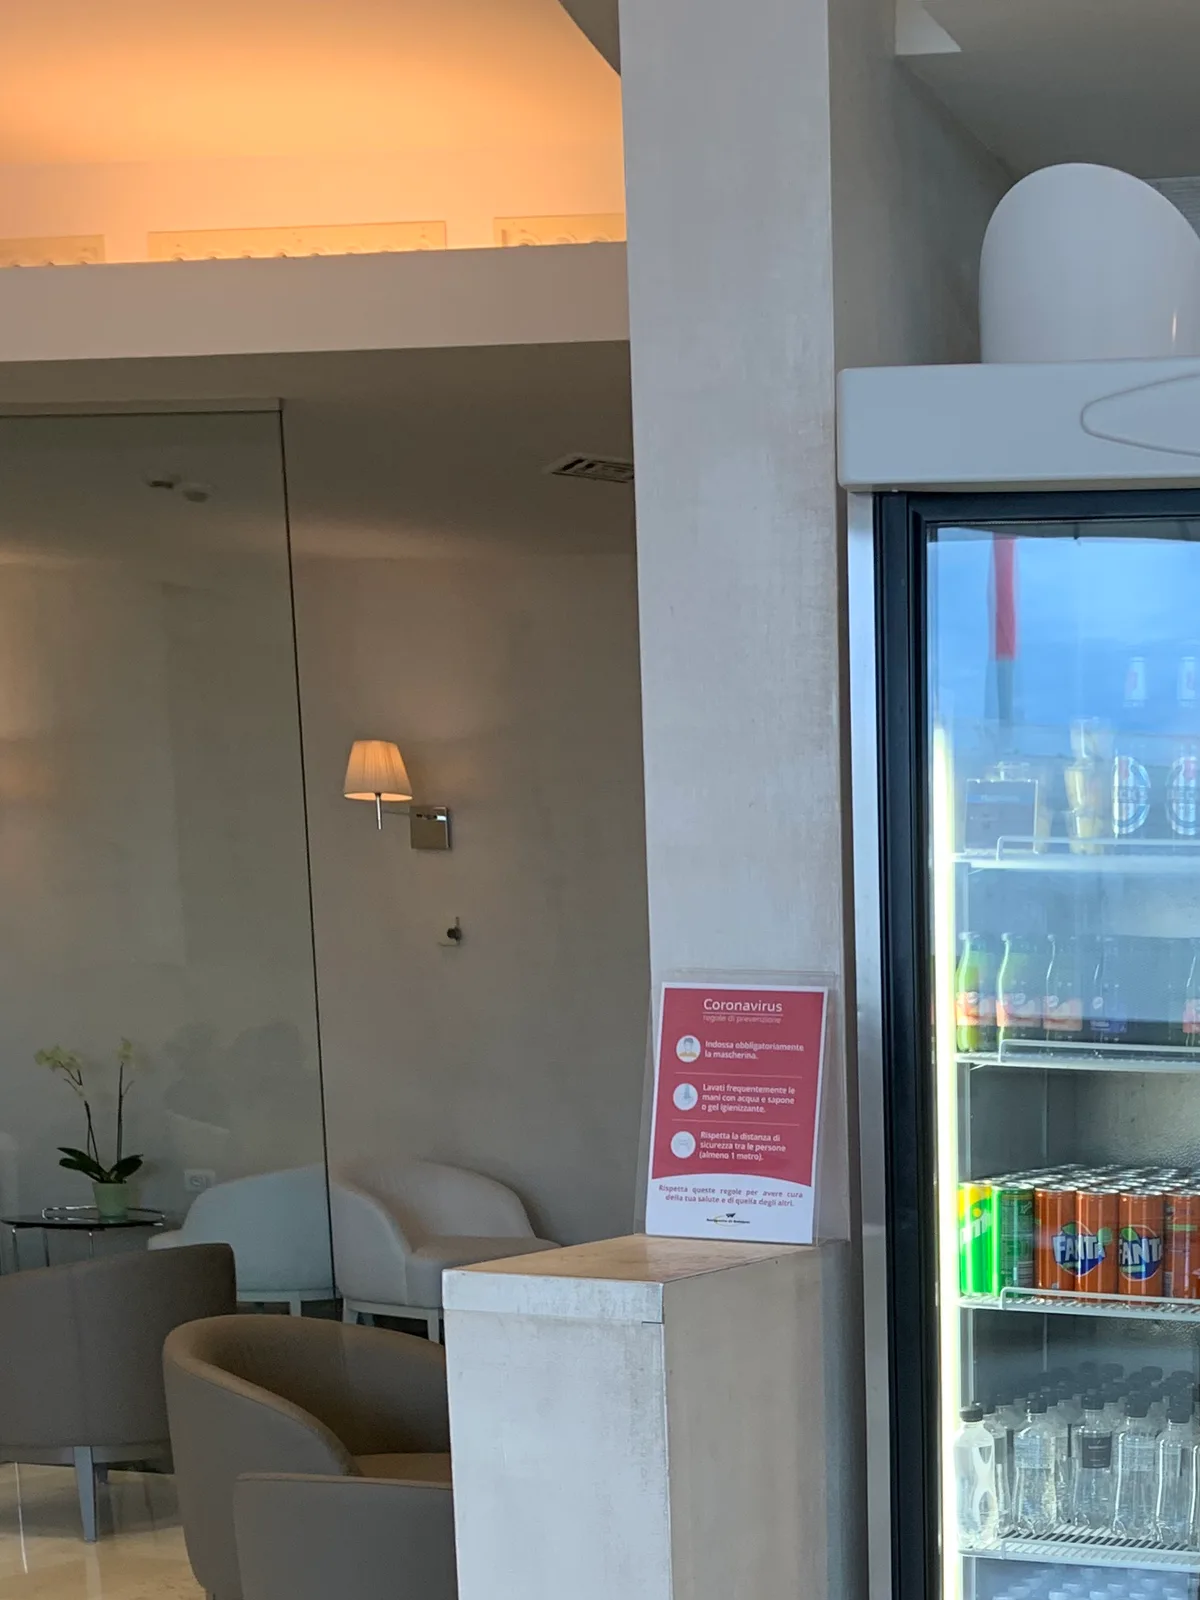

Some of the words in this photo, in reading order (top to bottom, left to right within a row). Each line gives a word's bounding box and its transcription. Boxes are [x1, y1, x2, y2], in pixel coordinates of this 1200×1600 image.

[703, 998, 783, 1013] Coronavirus
[705, 1040, 734, 1049] Indossa
[735, 1041, 804, 1052] obbligatoriamente
[704, 1050, 712, 1058] la
[703, 1083, 725, 1092] Lavati
[726, 1084, 787, 1095] frequentemente
[788, 1086, 796, 1094] le
[702, 1094, 721, 1102] mani
[737, 1096, 760, 1104] acqua
[767, 1097, 795, 1105] sapone
[707, 1103, 719, 1113] gel
[700, 1131, 731, 1141] Rispetta
[731, 1132, 740, 1140] la
[740, 1132, 772, 1142] distanza
[772, 1134, 781, 1142] di
[700, 1141, 734, 1149] sicurezza
[734, 1142, 746, 1150] tra
[747, 1142, 754, 1151] le
[754, 1144, 787, 1153] persone
[699, 1151, 730, 1160] (almeno
[658, 1184, 689, 1194] Rispetta
[692, 1186, 716, 1195] queste
[720, 1187, 742, 1197] regole
[745, 1189, 758, 1197] per
[762, 1190, 783, 1198] avere
[786, 1190, 803, 1199] cura
[665, 1193, 684, 1202] della
[697, 1194, 720, 1204] salute
